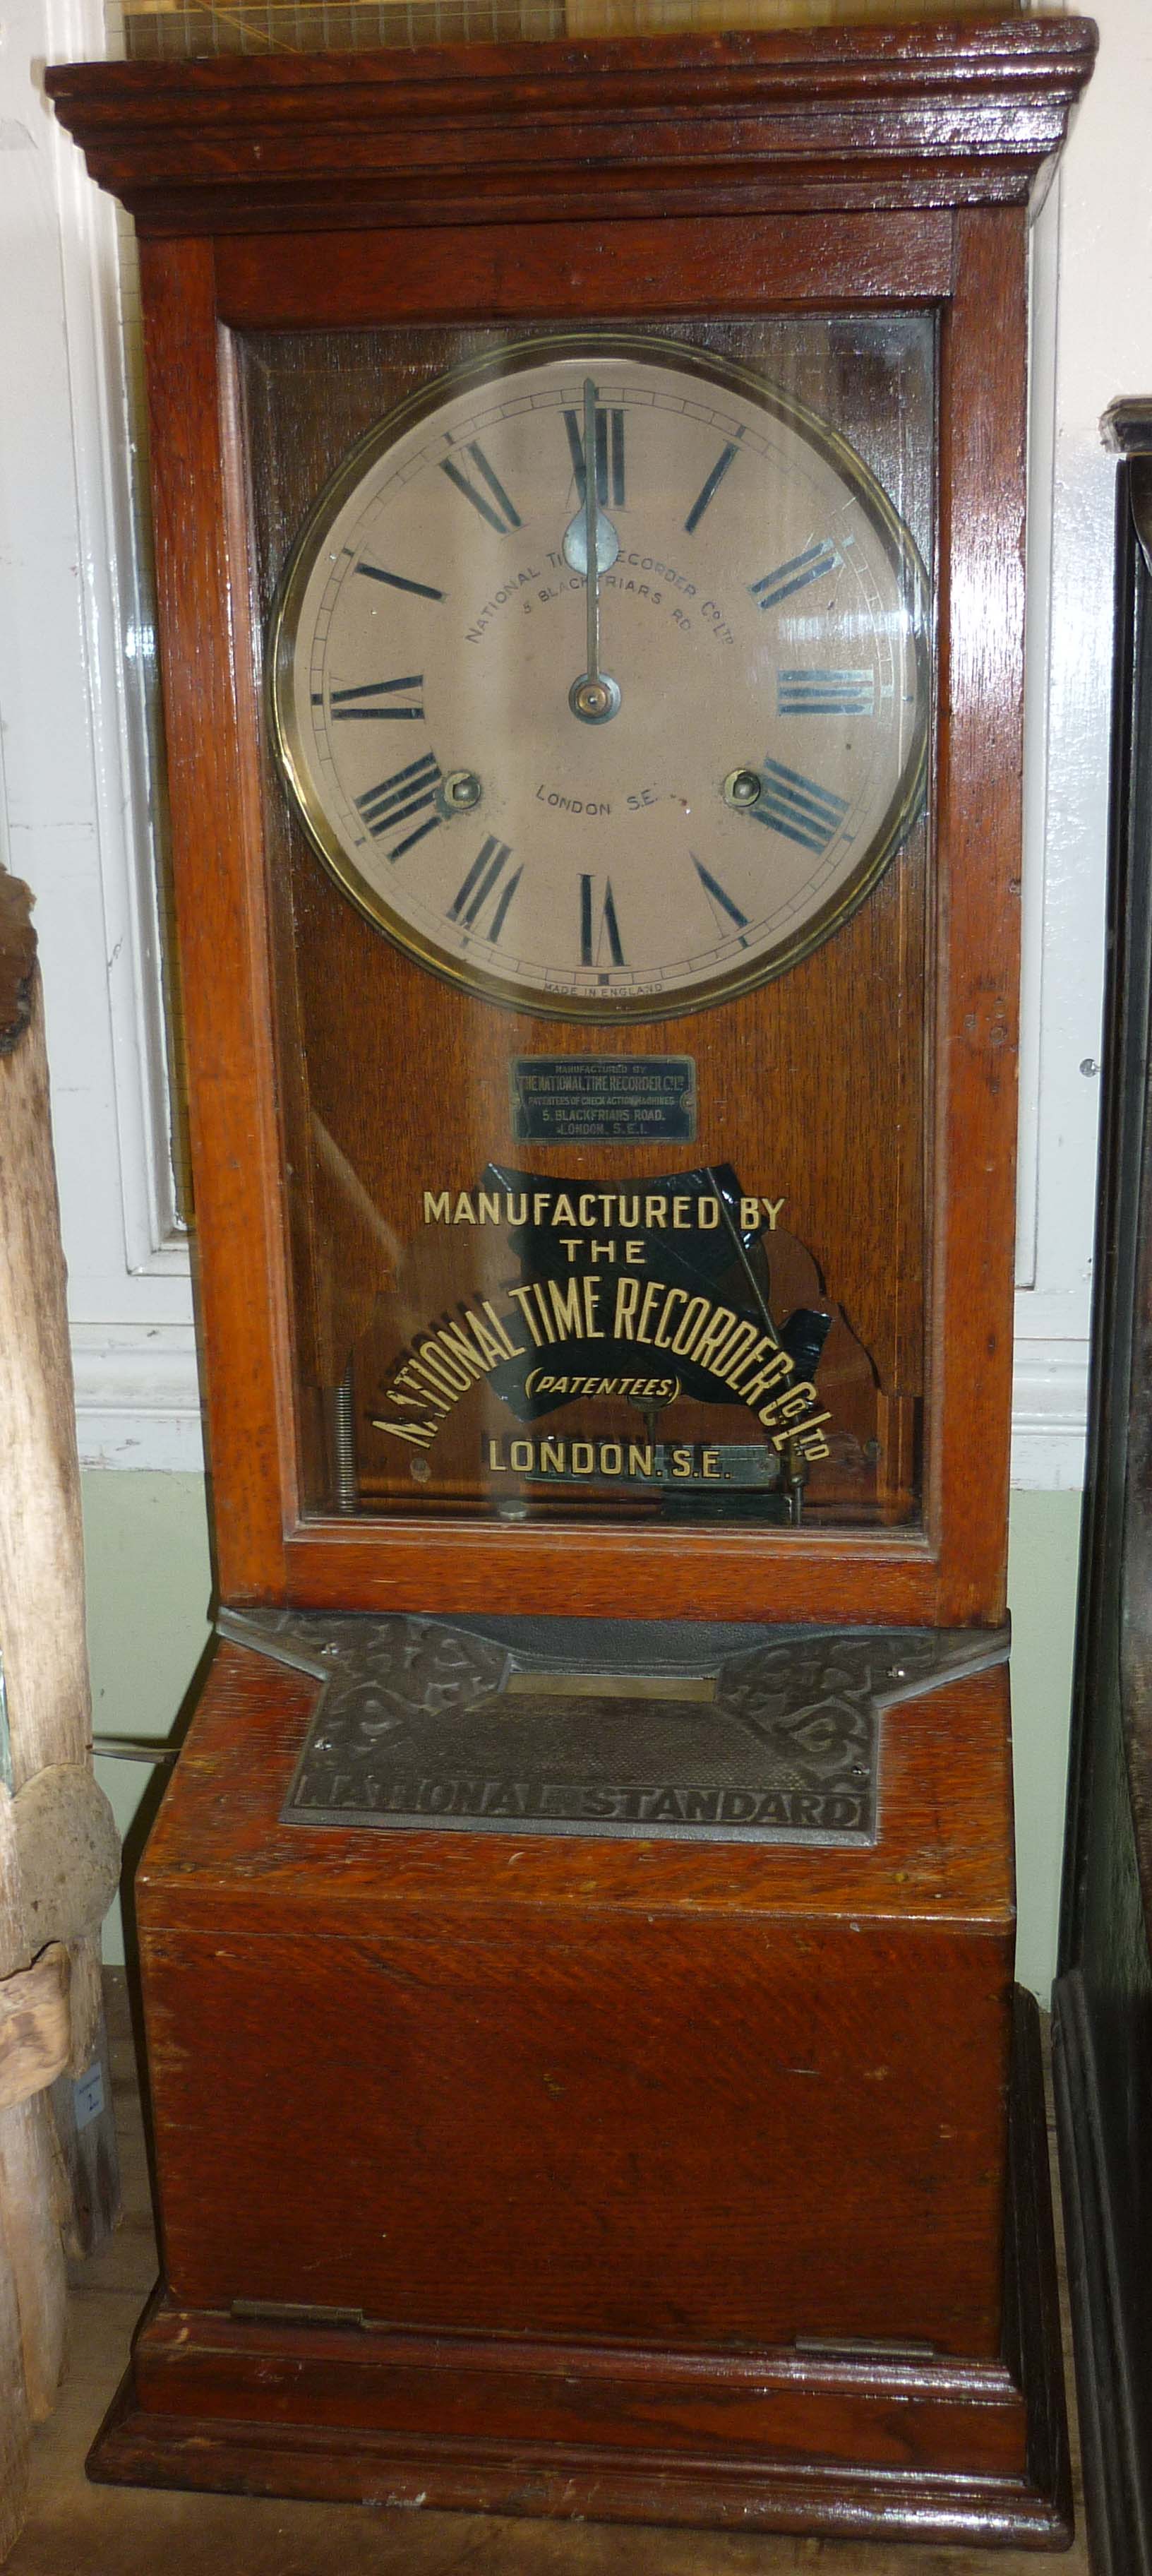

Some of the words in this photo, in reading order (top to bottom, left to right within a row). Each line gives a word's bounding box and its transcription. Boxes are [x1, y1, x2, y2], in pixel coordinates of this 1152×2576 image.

[465, 567, 541, 644] NATIONAL
[616, 550, 697, 600] ECORDER
[536, 785, 611, 816] LONDON
[545, 984, 577, 996] MADE
[584, 988, 596, 997] IN
[601, 983, 663, 997] ENGLAND
[517, 1075, 537, 1091] THE
[539, 1075, 584, 1091] NATIONAL
[584, 1075, 608, 1091] TIME
[609, 1075, 661, 1091] RECORDER
[555, 1065, 628, 1074] MANUFACTURED
[632, 1066, 646, 1074] BY
[555, 1109, 630, 1121] BLACKFRIARS
[424, 1192, 720, 1229] MANUFACTURED
[740, 1196, 788, 1232] BY
[559, 1239, 648, 1264] THE
[508, 1275, 606, 1347] TIME
[614, 1277, 795, 1405] RECORDER
[579, 1784, 863, 1827] STANDARD
